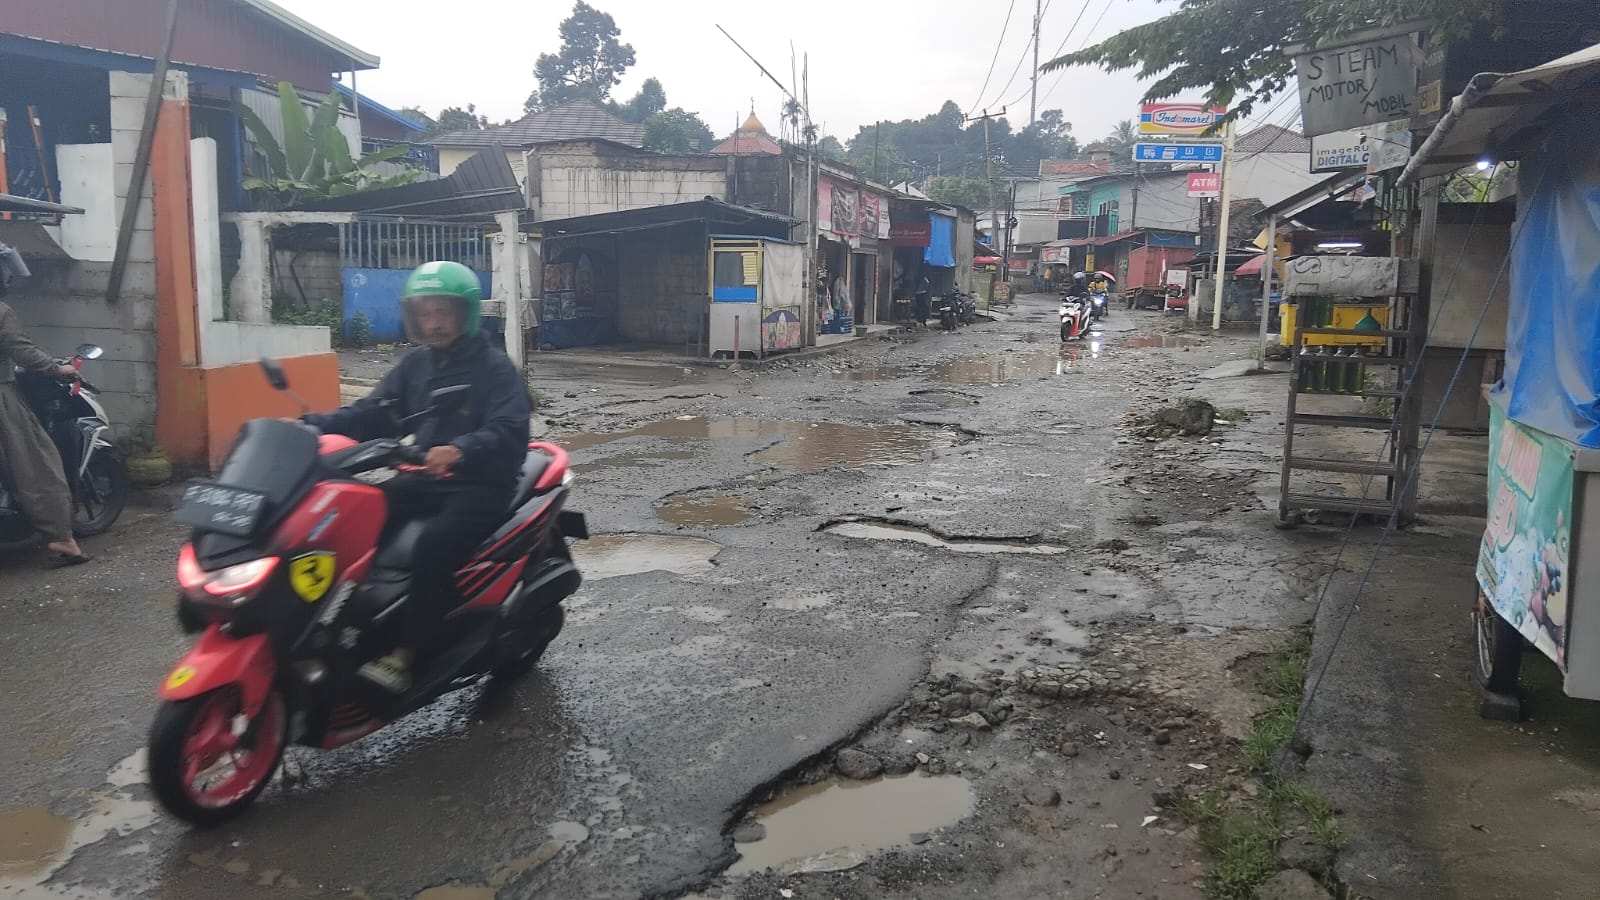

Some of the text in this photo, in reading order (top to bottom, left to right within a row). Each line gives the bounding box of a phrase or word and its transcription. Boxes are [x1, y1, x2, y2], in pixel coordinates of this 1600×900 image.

[1307, 44, 1398, 80] STEAM
[1155, 112, 1210, 124] Indomaret
[1317, 154, 1359, 166] DIGITAL
[1191, 178, 1217, 187] ATM
